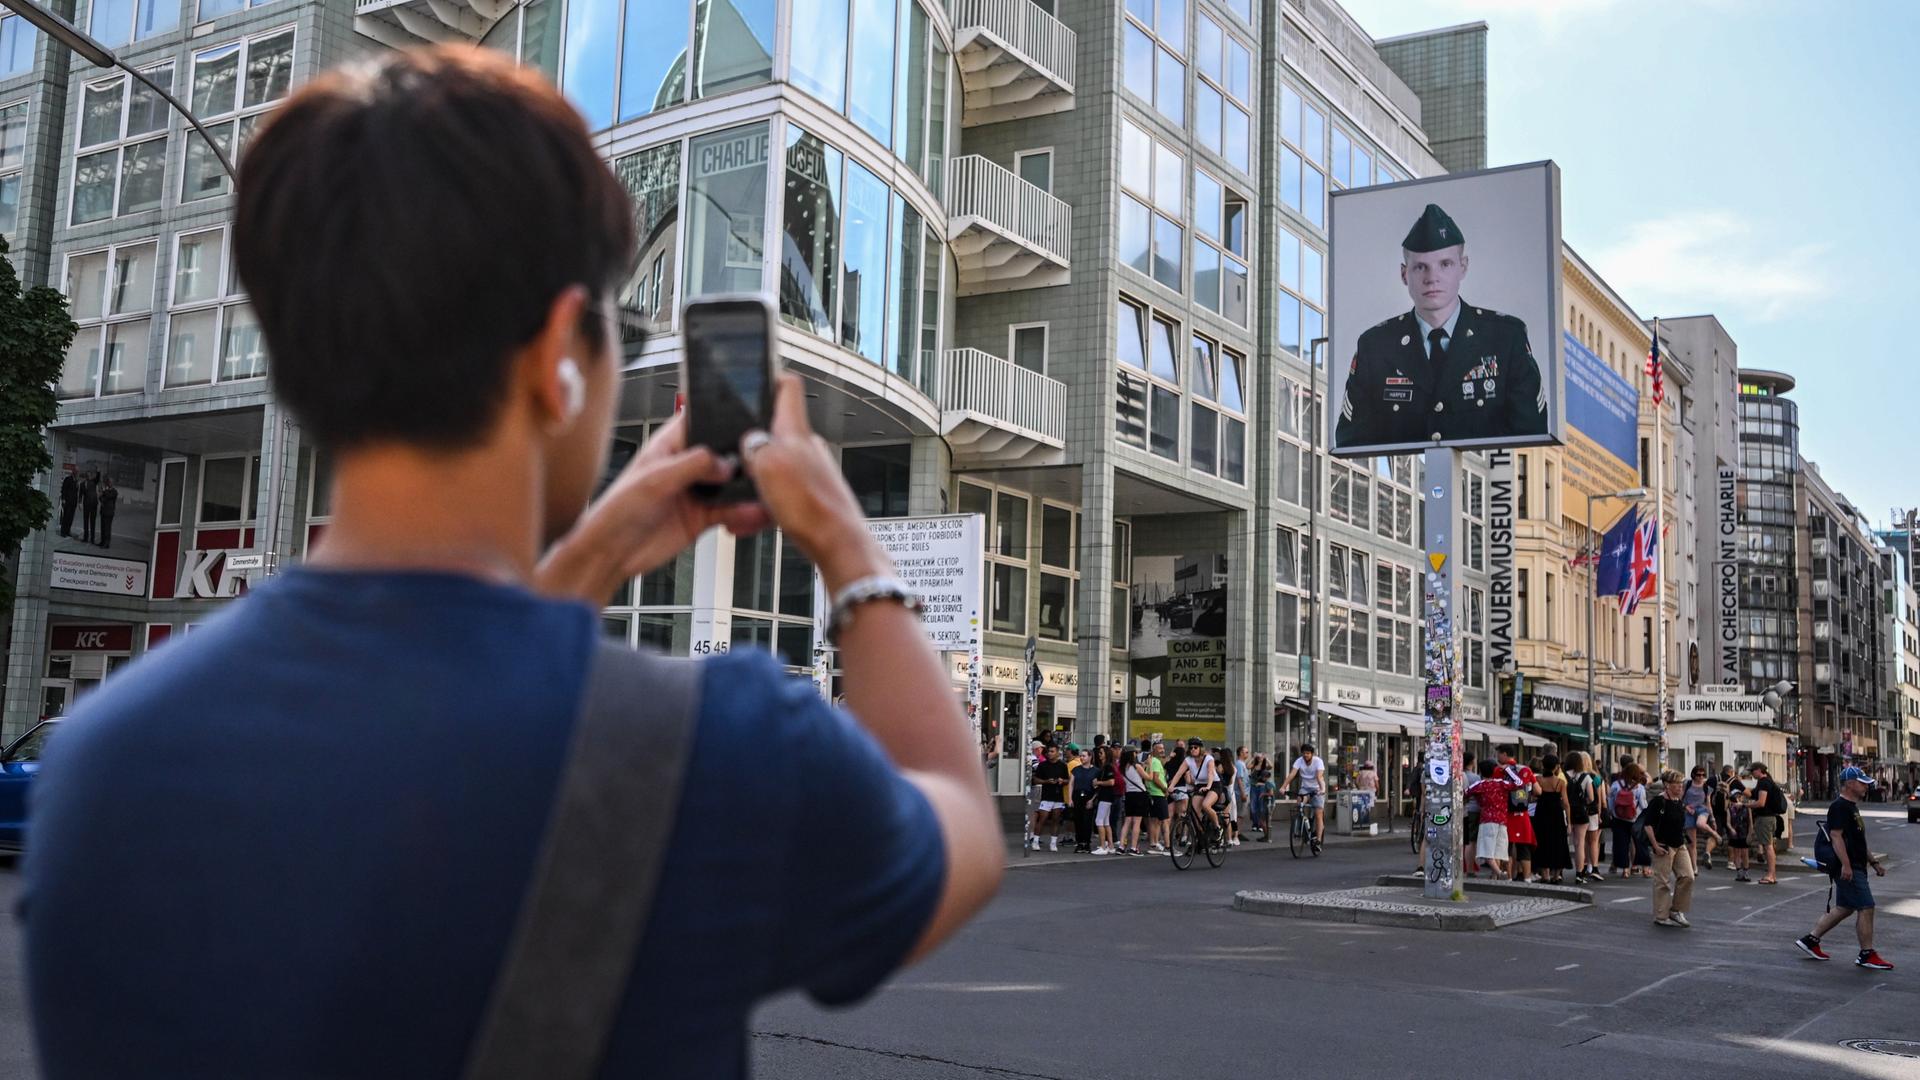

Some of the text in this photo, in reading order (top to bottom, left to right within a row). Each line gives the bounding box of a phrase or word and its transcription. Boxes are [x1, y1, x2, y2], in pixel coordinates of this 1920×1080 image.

[702, 134, 769, 174] CHARLIE
[1720, 470, 1735, 536] CHARLIE
[894, 522, 904, 531] THE
[907, 521, 937, 531] AMERICAN
[940, 519, 963, 529] SECTOR
[898, 532, 908, 541] OFF
[912, 532, 926, 541] DUTY
[929, 530, 962, 540] FORBIDDEN
[886, 542, 929, 552] TRAFFIC RULES
[60, 566, 77, 575] Liberty
[90, 569, 118, 579] Democracy
[174, 549, 250, 598] KF
[1491, 480, 1512, 663] MAUERMUSEUM
[1721, 540, 1737, 641] CHECKPOINT
[929, 594, 962, 602] AMERICAIN
[934, 604, 941, 612] DU
[942, 604, 963, 612] SERVICE
[920, 614, 954, 623] IRCULATION
[75, 631, 108, 648] KFC
[938, 631, 960, 640] SEKTOR
[693, 640, 711, 654] 45
[713, 640, 728, 655] 45
[1173, 640, 1210, 653] COME
[1176, 658, 1218, 669] AND BE
[1723, 646, 1737, 673] AM
[996, 666, 1018, 680] CHARLIE
[1172, 672, 1226, 684] PART OF
[1136, 698, 1160, 707] MAUER
[1533, 694, 1583, 715] CHECKPOINT CHARLIE
[1680, 700, 1766, 712] US ARMY CHECKPOINT
[1136, 707, 1160, 715] MUSEUM
